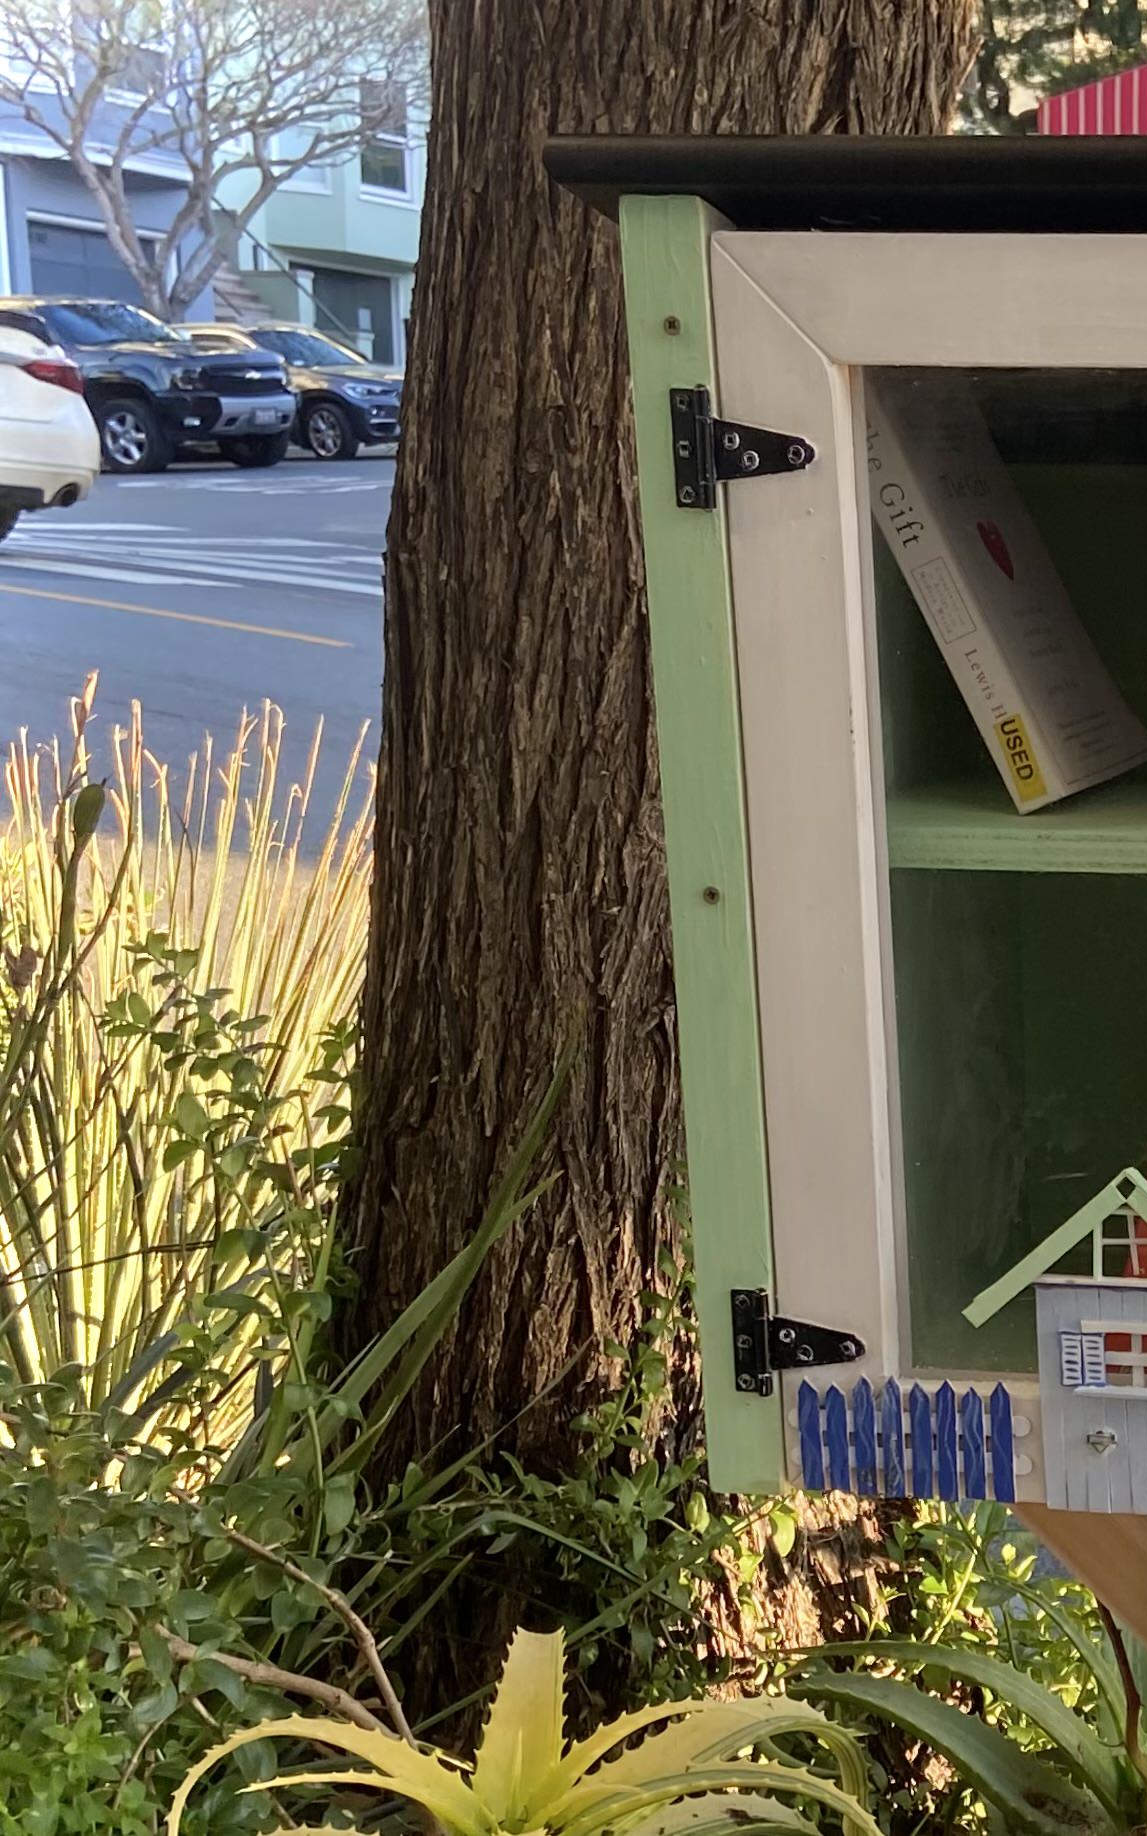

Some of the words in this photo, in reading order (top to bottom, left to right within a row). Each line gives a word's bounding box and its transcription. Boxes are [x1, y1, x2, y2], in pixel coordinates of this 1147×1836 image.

[879, 483, 924, 547] Gift
[965, 648, 995, 701] Lewis
[1000, 719, 1034, 781] USED
